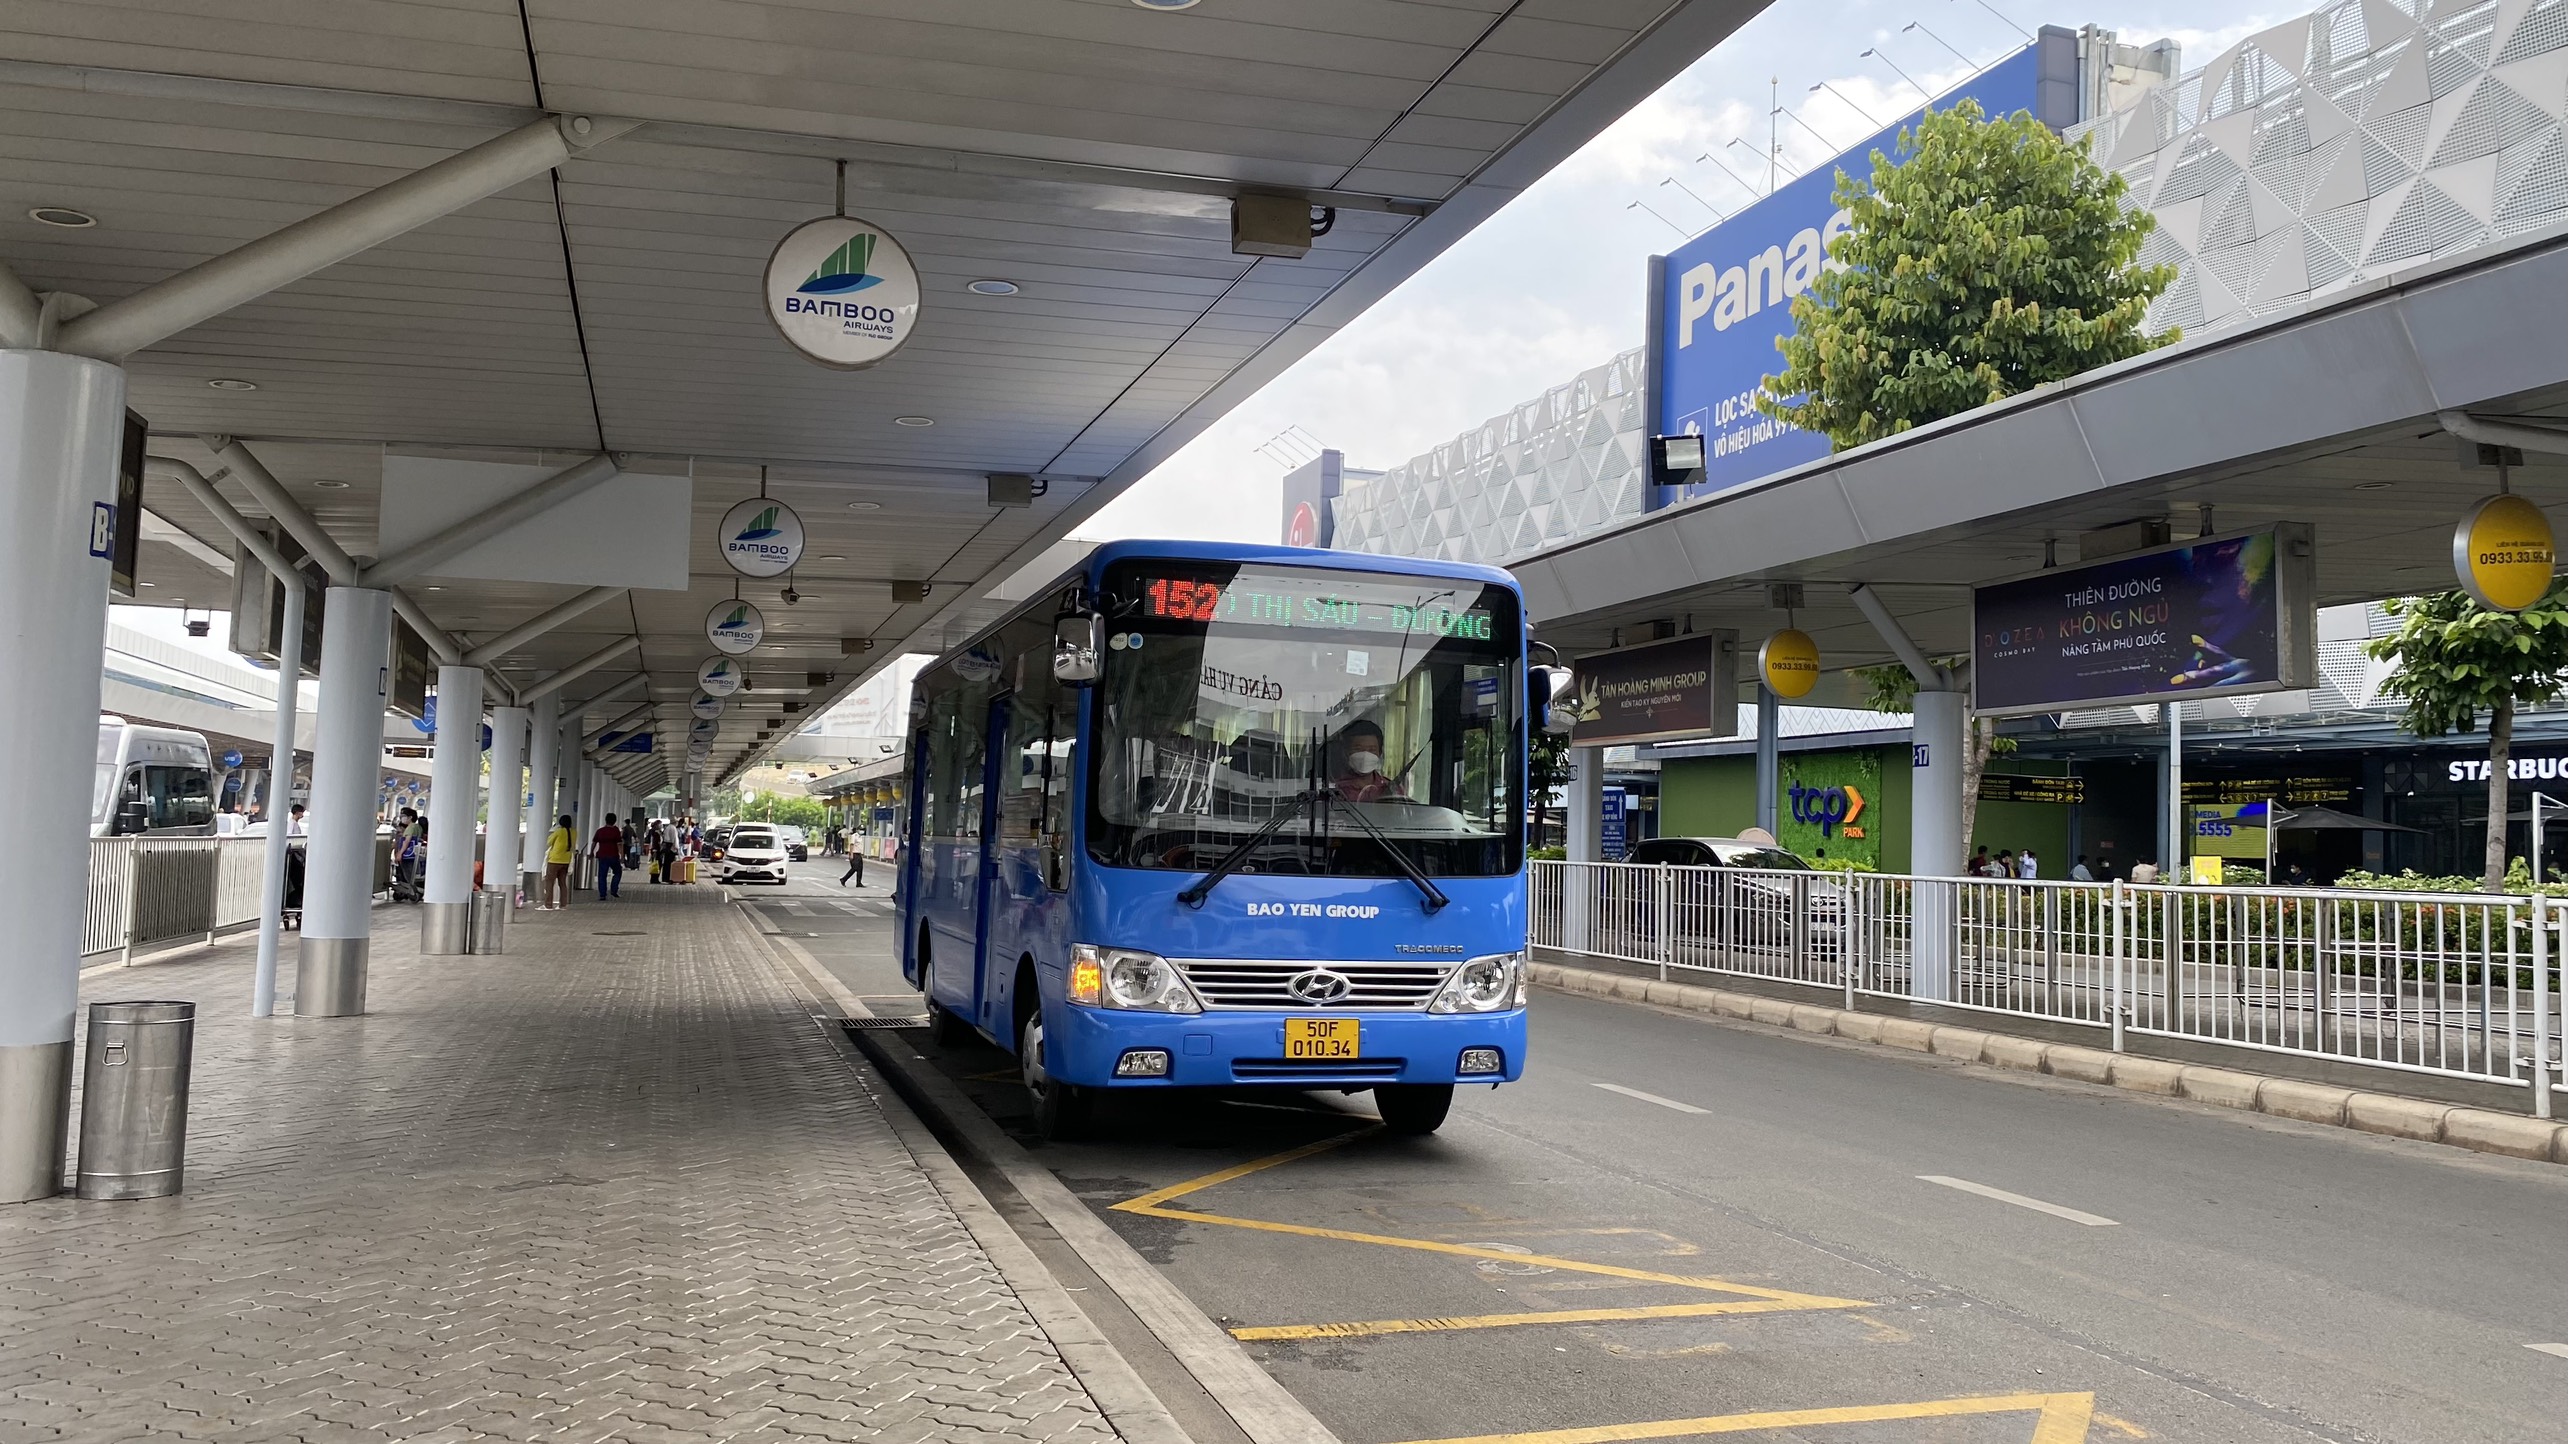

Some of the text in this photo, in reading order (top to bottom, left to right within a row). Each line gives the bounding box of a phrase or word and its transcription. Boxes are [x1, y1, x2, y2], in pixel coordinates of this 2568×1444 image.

[1679, 206, 1862, 350] Panas
[786, 297, 895, 323] BAMBOO
[843, 320, 894, 334] AIRWAYS
[1715, 395, 1738, 429] LỌC
[1714, 431, 1727, 458] VÔ
[1728, 425, 1750, 454] HIỆU
[1752, 417, 1774, 446] HÓA
[729, 543, 789, 555] BAMBOO
[760, 553, 788, 561] AIRWAYS
[1149, 578, 1219, 620] 152
[2065, 577, 2162, 608] THIÊN ĐƯỜNG
[1246, 593, 1292, 627] THỊ
[1303, 593, 1358, 624] SÁU
[2060, 597, 2169, 638] KHÔNG NGỦ
[712, 630, 754, 640] BAMBOO
[2062, 629, 2167, 657] NÂNG TẦM PHÚ QUỐC
[1994, 646, 2036, 659] COSMO BAY
[702, 678, 735, 686] BAMBOO
[1619, 677, 1648, 697] HOÀNG
[1650, 675, 1672, 693] MINH
[1673, 670, 1707, 689] GROUP
[1788, 779, 1848, 838] tcp
[1843, 826, 1864, 838] PARK
[1247, 903, 1380, 919] BAO YEN GROUP
[1307, 1021, 1339, 1037] 50F
[1293, 1040, 1351, 1056] 010.34
